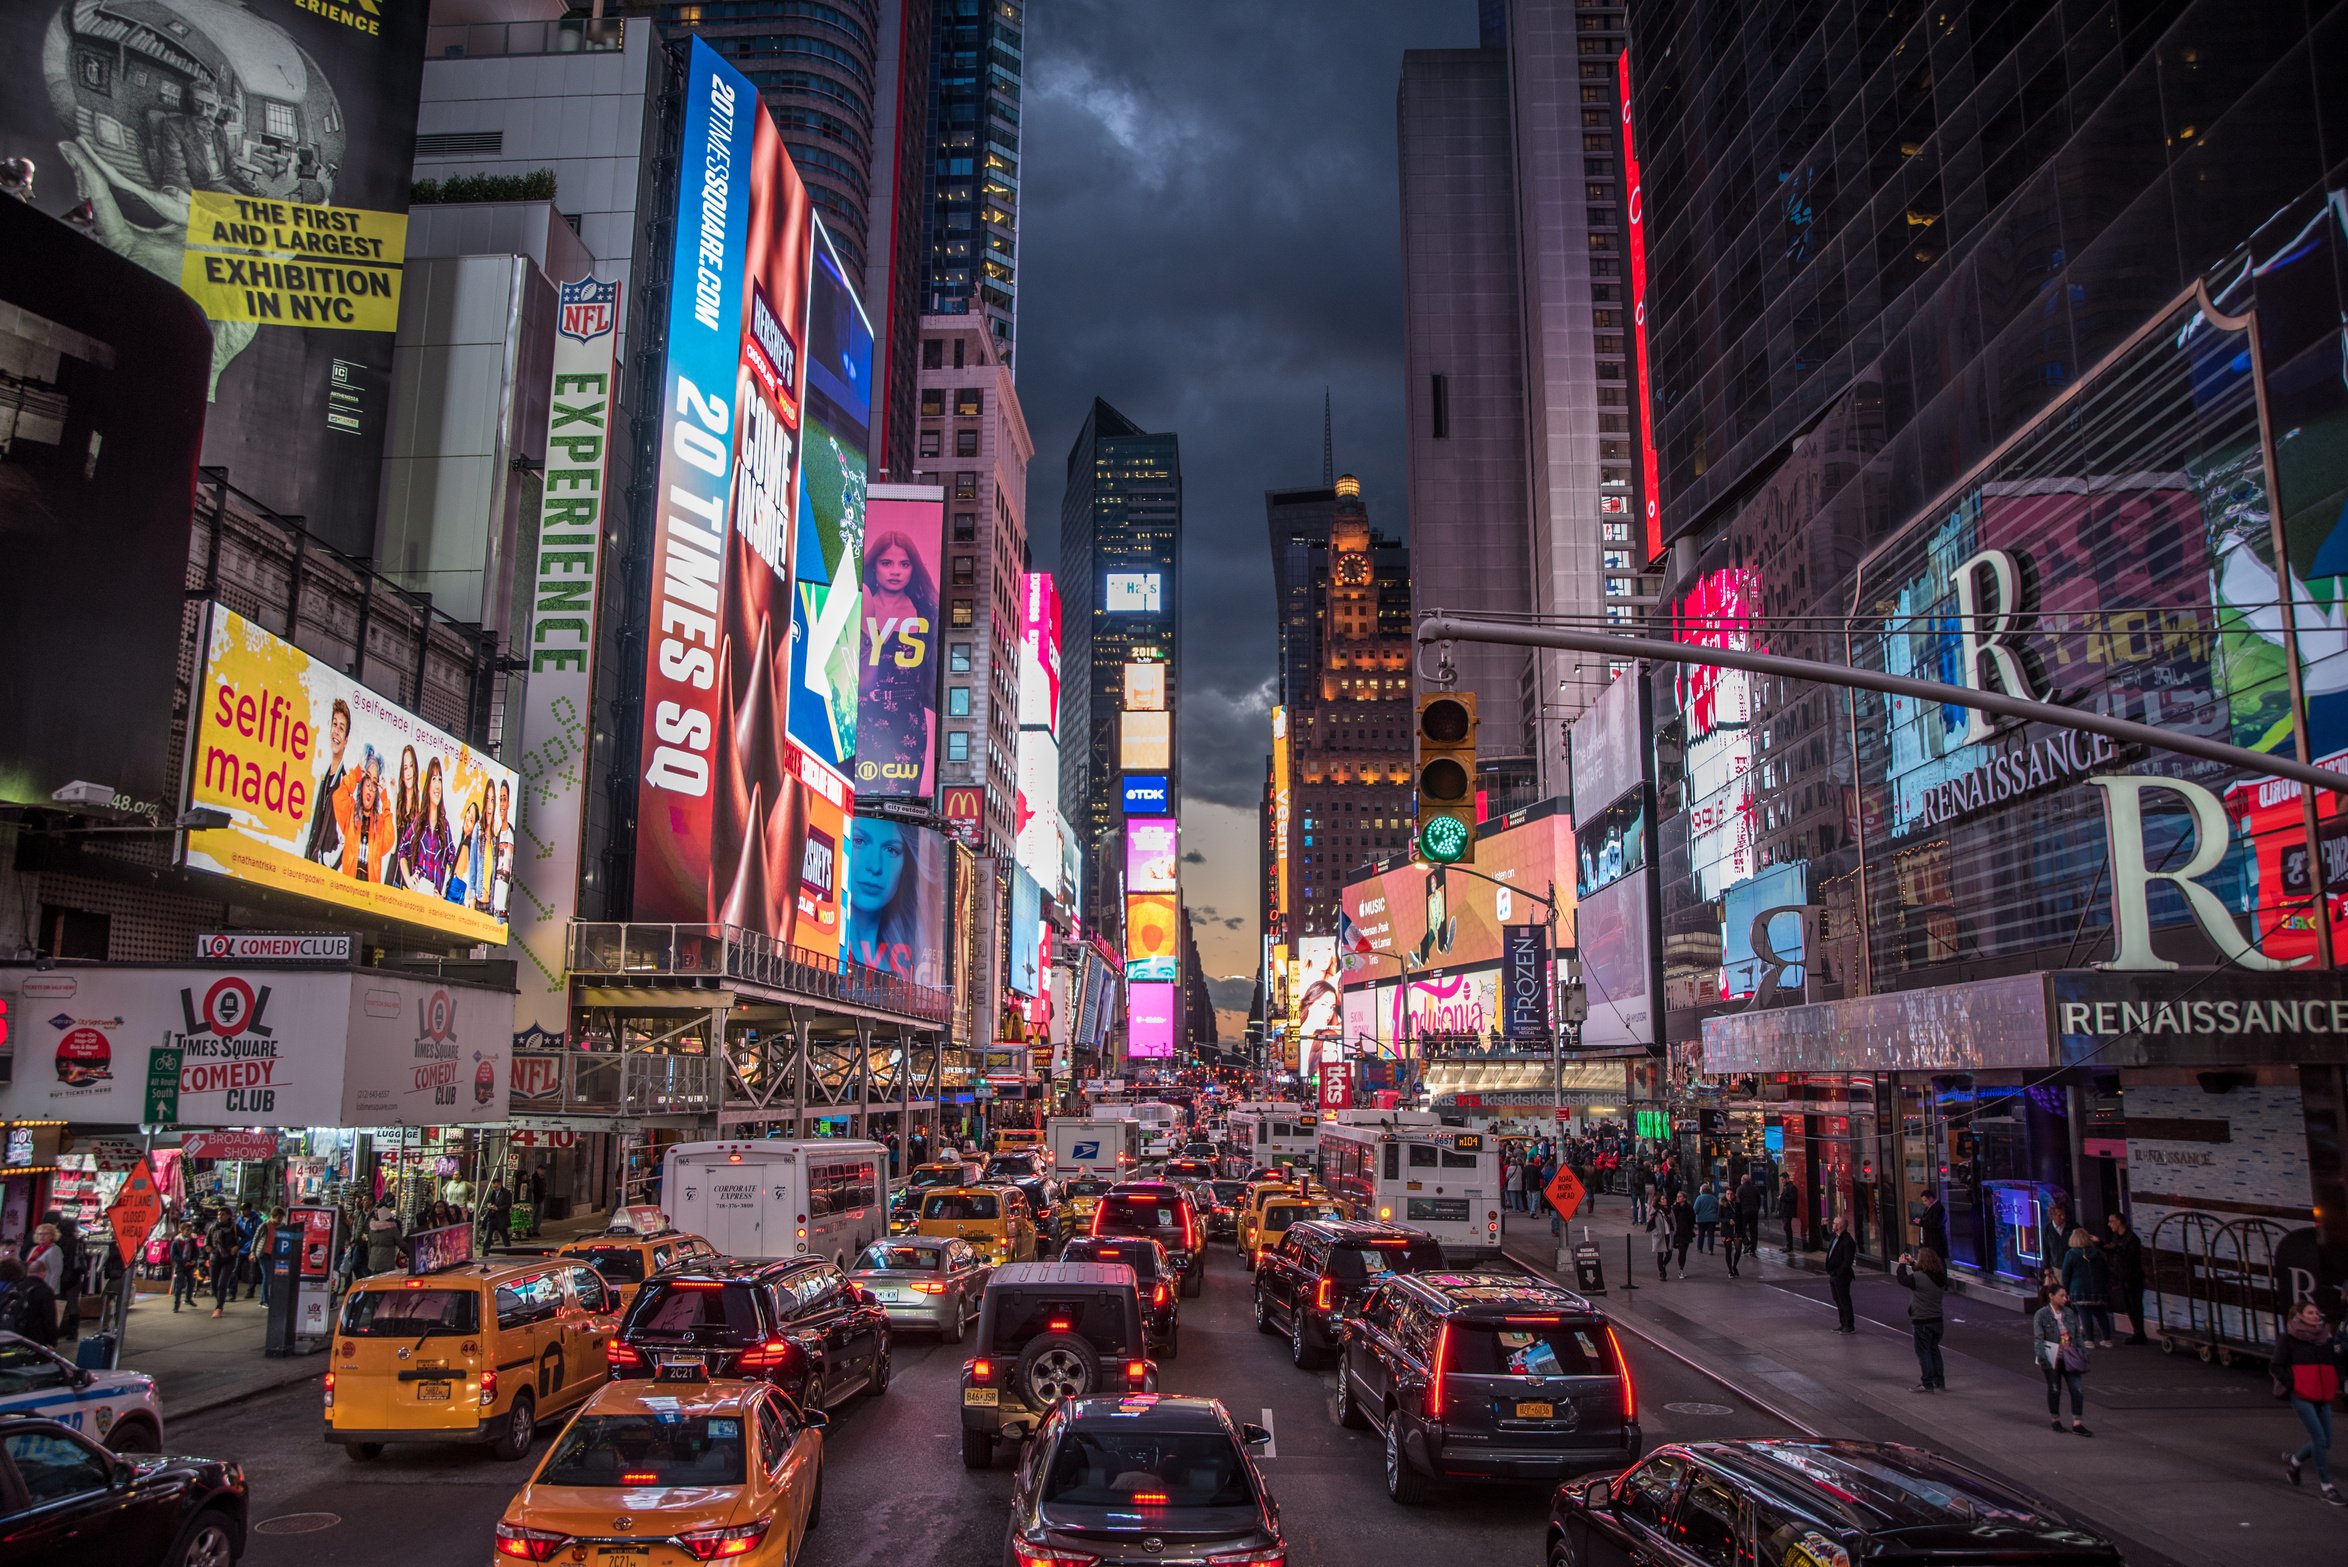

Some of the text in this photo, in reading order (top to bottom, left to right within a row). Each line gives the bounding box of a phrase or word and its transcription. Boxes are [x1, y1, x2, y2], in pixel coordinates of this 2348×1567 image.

[234, 199, 360, 233] THE FIRST
[212, 221, 383, 258] AND LARGEST
[204, 256, 391, 297] EXHIBITION
[246, 290, 354, 323] IN NYC
[564, 305, 610, 333] NFL
[754, 293, 794, 388] HERSHEY'S
[334, 367, 346, 377] IC
[741, 380, 793, 511] COME
[532, 372, 608, 674] EXPERIENCE
[736, 467, 787, 583] INSIDE!
[645, 375, 730, 797] 20 TIMES SQ
[866, 617, 929, 668] YS
[1950, 549, 2056, 747] R
[215, 684, 309, 760] selfie
[352, 689, 485, 773] @selfiemade getselfiemade.com
[204, 745, 306, 820] made
[882, 762, 918, 780] CW
[1920, 714, 2114, 828] RENAISSANCE
[1136, 789, 1164, 799] TDK
[887, 803, 926, 816] city outdoor
[1276, 788, 1288, 859] veem
[2086, 776, 2313, 972] R
[1364, 897, 1386, 916] MUSIC
[974, 869, 989, 1005] PALACE
[1513, 938, 1541, 1023] FROZEN
[180, 977, 273, 1037] LOL
[1350, 1011, 1364, 1024] SKIN
[2060, 1000, 2348, 1036] RENAISSANCE
[174, 1032, 278, 1061] TIMES SQUARE
[414, 1038, 460, 1061] TIMES SQUARE
[160, 1077, 177, 1086] Route
[179, 1059, 275, 1092] COMEDY
[415, 1062, 458, 1089] COMEDY
[511, 1058, 557, 1092] NFL
[1327, 1064, 1347, 1104] tkts
[151, 1088, 175, 1098] South
[226, 1089, 275, 1112] CLUB
[435, 1086, 456, 1105] CLUB
[208, 1134, 278, 1145] BROADWAY
[377, 1131, 418, 1139] LUGGGE
[1434, 1137, 1453, 1145] 6657
[1459, 1136, 1478, 1147] M104
[224, 1147, 268, 1158] SHOWS
[678, 1157, 796, 1166] 065 065
[713, 1184, 758, 1193] CORPORATE
[1558, 1175, 1573, 1183] ROAD
[135, 1194, 153, 1206] LANE
[720, 1192, 753, 1200] EXPRESS
[1555, 1192, 1575, 1200] AHEAD
[122, 1211, 146, 1223] CLOSED
[121, 1225, 144, 1237] AHEAD
[280, 1240, 289, 1253] P
[2289, 1267, 2318, 1304] R
[462, 1343, 475, 1352] 44
[670, 1367, 694, 1378] 2C21
[966, 1392, 996, 1402] B46 JSR
